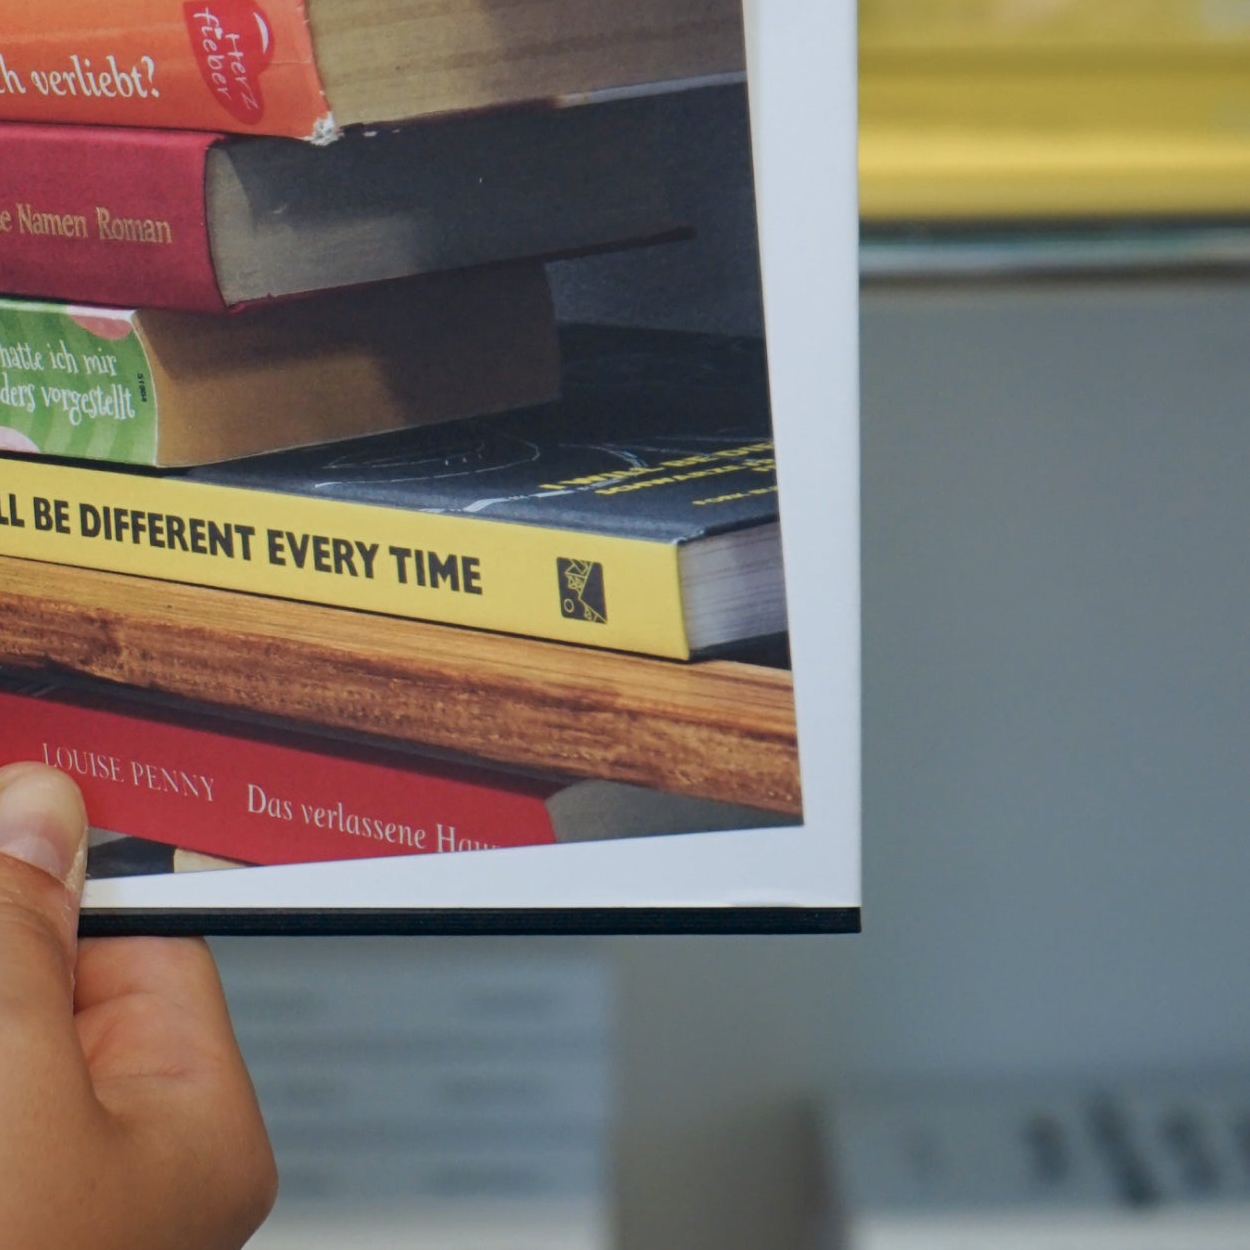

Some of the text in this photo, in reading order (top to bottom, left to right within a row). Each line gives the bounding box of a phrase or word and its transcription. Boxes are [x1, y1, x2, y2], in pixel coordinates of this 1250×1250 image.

[30, 53, 161, 99] verliebt?
[225, 32, 259, 110] Herz
[16, 202, 89, 238] Namen
[95, 206, 173, 244] Roman
[46, 339, 79, 375] ich
[82, 347, 118, 377] mir
[41, 383, 136, 426] vorgestellt
[33, 496, 71, 534] BE
[79, 502, 256, 562] DIFFERENT
[266, 528, 380, 580] EVERY
[388, 545, 483, 595] TIME
[42, 742, 215, 803] LOUISE PENNY
[247, 783, 293, 821] Das
[300, 801, 426, 850] verlassene
